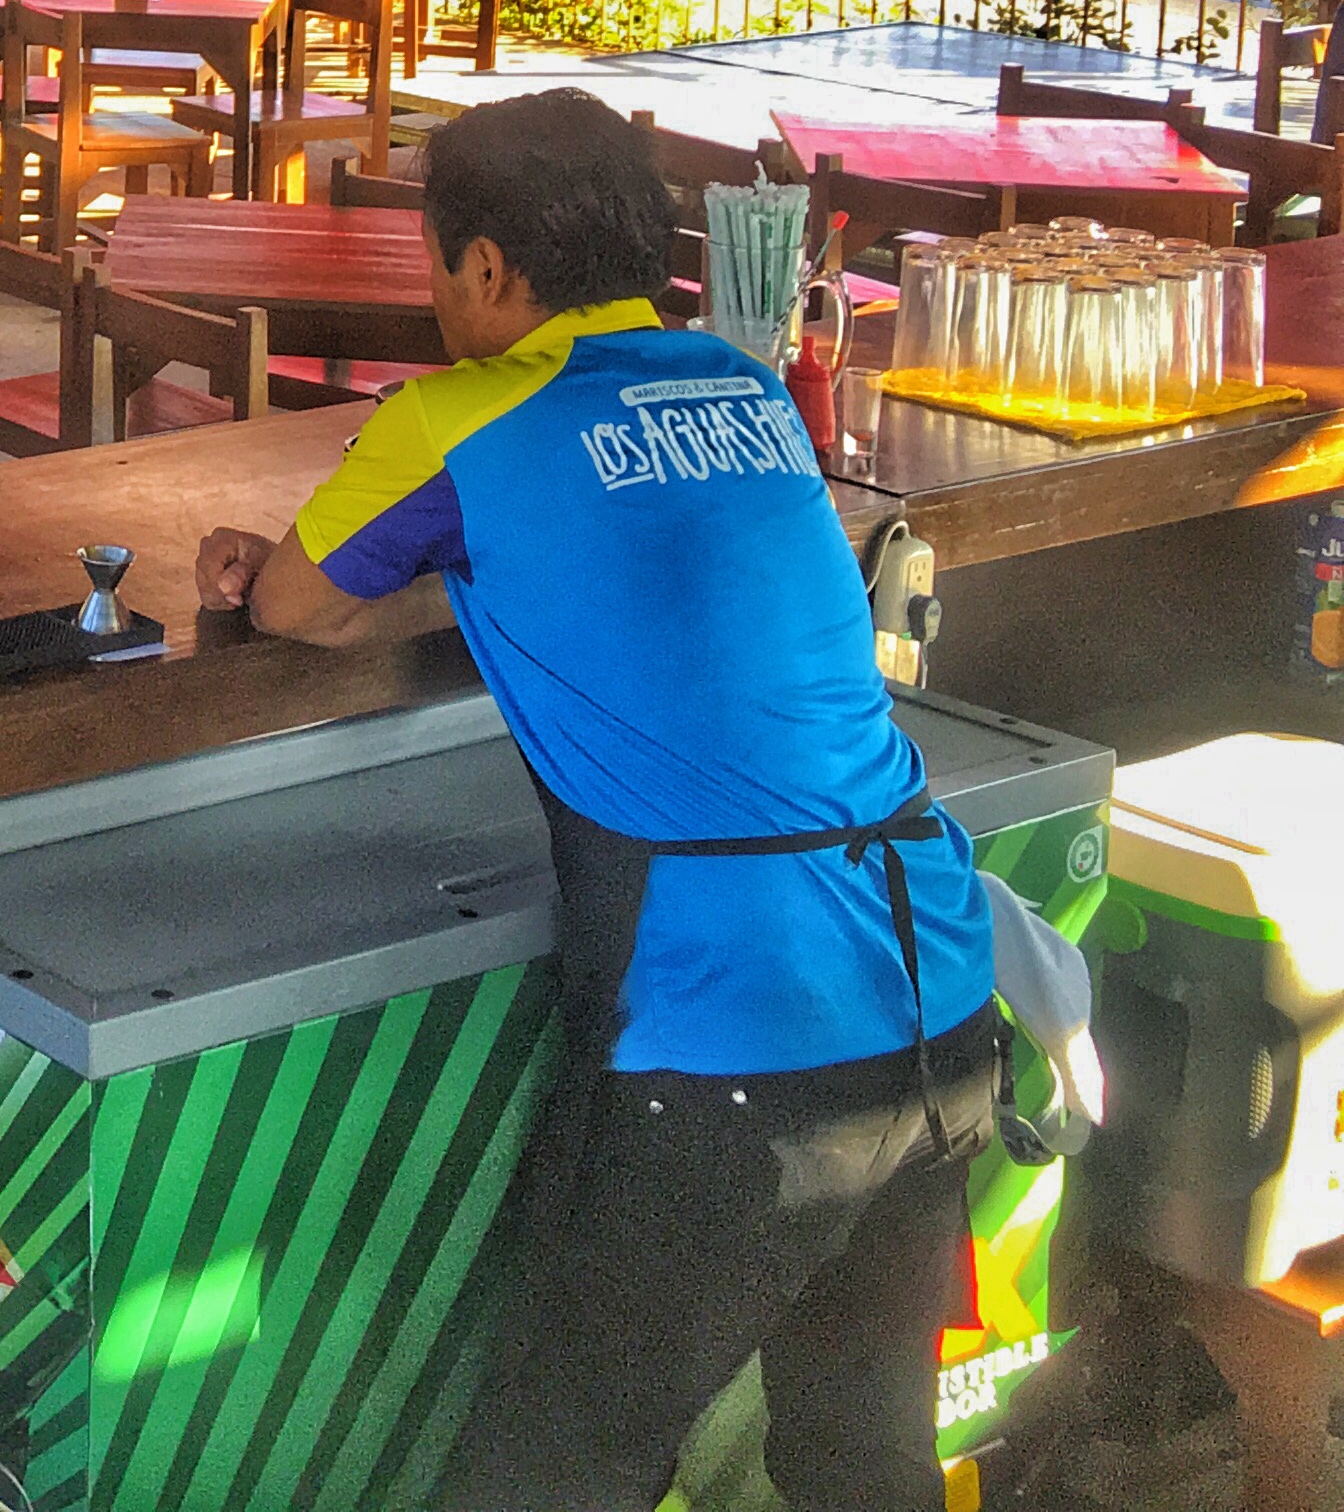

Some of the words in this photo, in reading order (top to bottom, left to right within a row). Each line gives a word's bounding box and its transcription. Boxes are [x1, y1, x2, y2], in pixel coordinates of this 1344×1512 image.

[632, 384, 689, 399] MARISCOS
[705, 380, 752, 394] CANTINA
[580, 422, 651, 484] LOS
